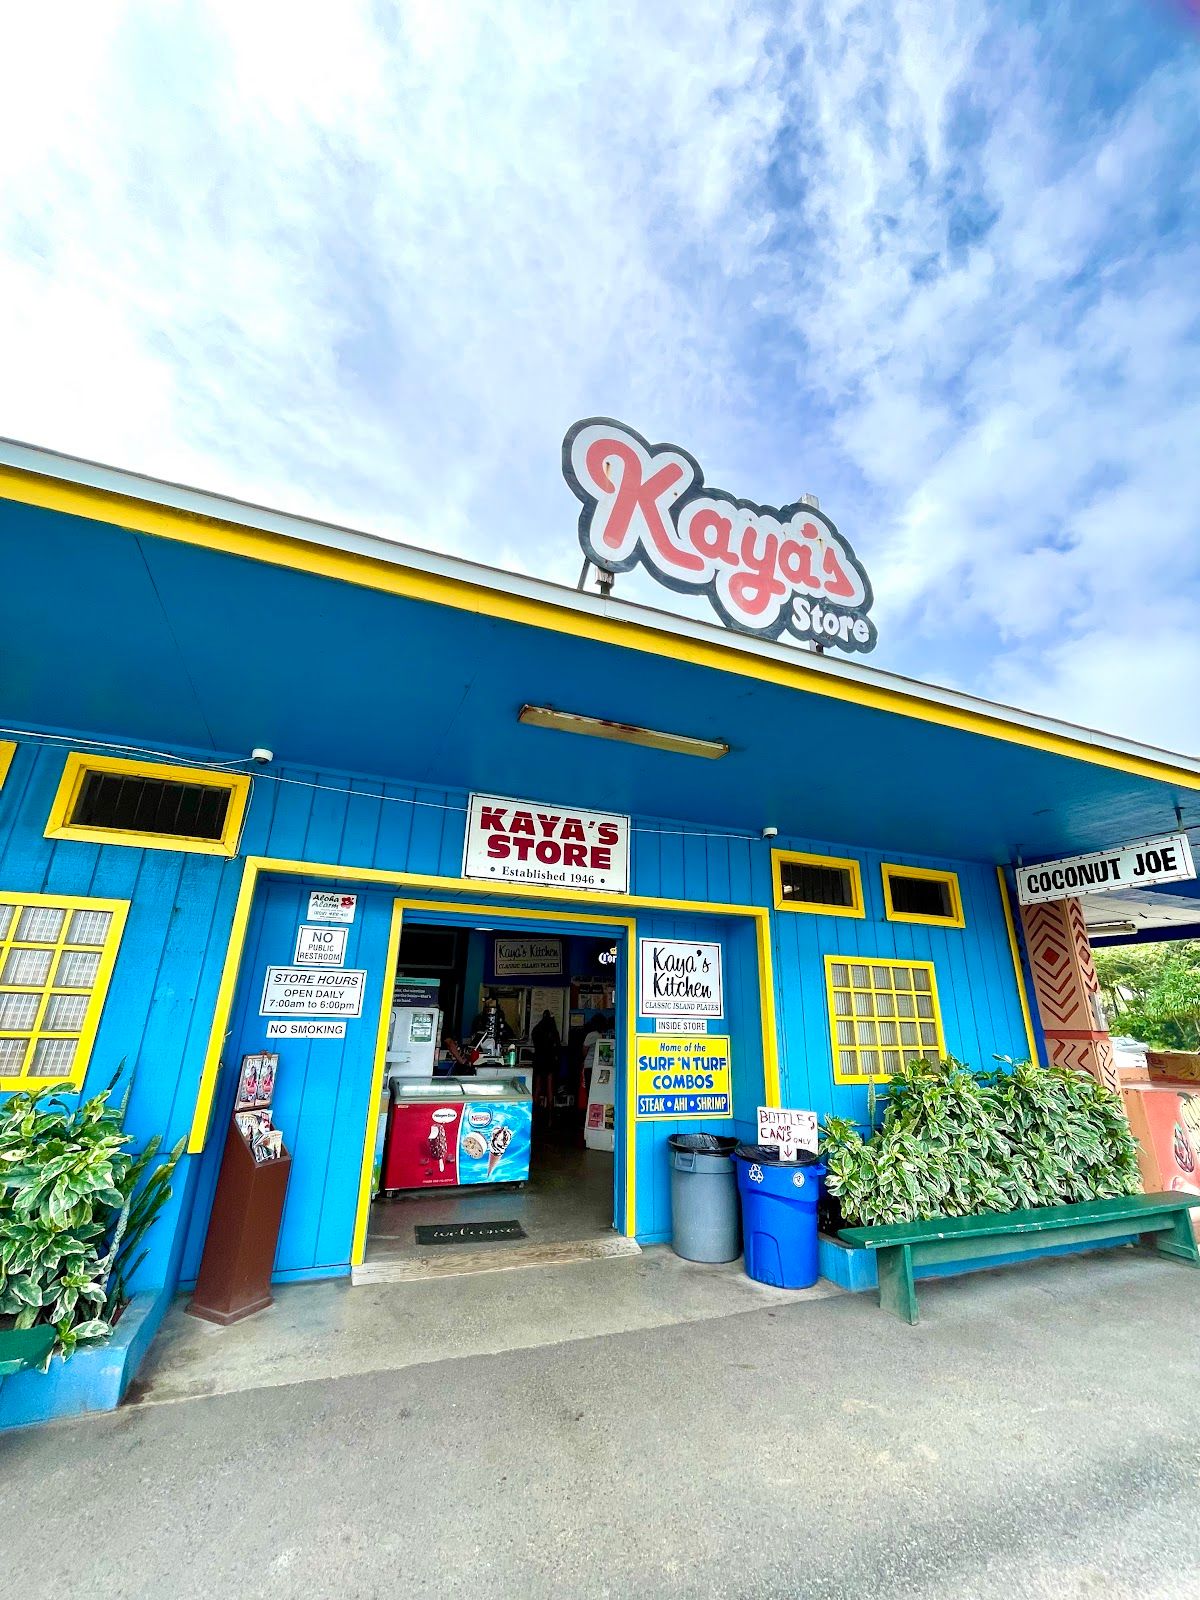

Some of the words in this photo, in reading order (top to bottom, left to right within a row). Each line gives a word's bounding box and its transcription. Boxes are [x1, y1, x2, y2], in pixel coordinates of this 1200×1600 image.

[586, 438, 855, 616] Kaya's
[791, 596, 869, 643] Store
[480, 806, 619, 846] KAYA'S
[487, 834, 611, 870] STORE
[502, 865, 566, 882] Established
[570, 873, 595, 885] 1946
[1027, 857, 1121, 894] COCONUT
[1133, 847, 1177, 876] JOE
[313, 894, 339, 903] Aloha
[312, 931, 333, 943] NO
[308, 943, 334, 952] PUBLIC
[299, 951, 340, 961] RESTROOM
[653, 946, 712, 978] Kaya's
[273, 973, 316, 984] STORE
[317, 975, 359, 985] HOURS
[653, 972, 712, 999] Kitchen
[284, 988, 313, 998] OPEN
[315, 990, 345, 999] DAILY
[269, 999, 305, 1008] 7:00am
[308, 1000, 317, 1009] to
[319, 1000, 355, 1011] 6:00pm
[645, 1001, 672, 1010] CLASSIC
[672, 1002, 696, 1010] ISLAND
[696, 1003, 719, 1011] PLATES
[269, 1024, 288, 1034] NO
[290, 1025, 343, 1034] SMOKING
[658, 1021, 681, 1030] INSIDE
[683, 1022, 706, 1031] STORE
[659, 1043, 682, 1052] Home
[684, 1042, 692, 1052] of
[693, 1042, 706, 1052] the
[639, 1055, 675, 1071] SURF
[693, 1056, 727, 1071] TURF
[652, 1074, 714, 1090] COMBOS
[639, 1097, 665, 1112] STEAK
[674, 1097, 688, 1112] AHI
[696, 1096, 727, 1111] SHRIMP
[759, 1110, 816, 1130] BOTTLES
[760, 1127, 792, 1143] CANS
[793, 1137, 812, 1145] ONLY
